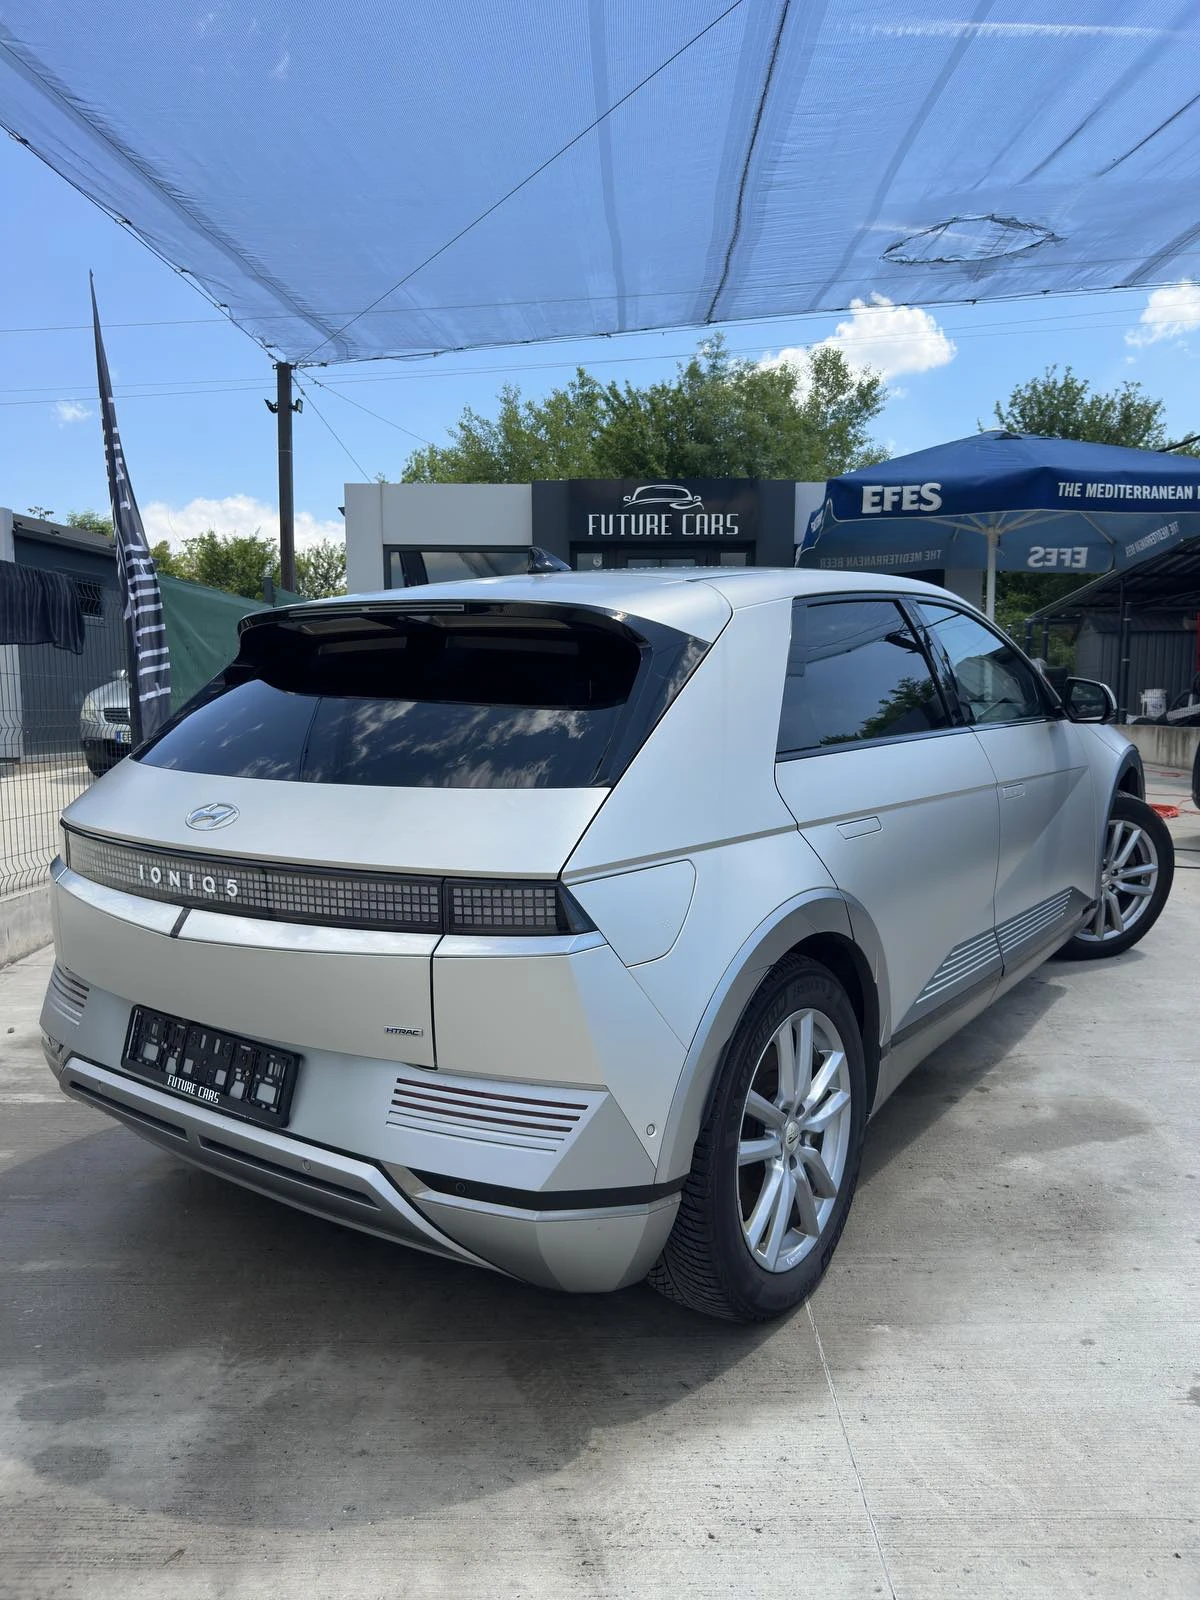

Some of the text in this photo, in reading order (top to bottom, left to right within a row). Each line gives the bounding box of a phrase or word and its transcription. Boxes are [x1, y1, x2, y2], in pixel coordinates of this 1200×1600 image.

[861, 483, 943, 514] EFES
[1058, 482, 1082, 498] THE
[1086, 483, 1193, 500] MEDITERRANEAN
[588, 513, 739, 536] FUTURE CARS
[385, 1027, 421, 1036] HTRAC
[167, 1074, 221, 1104] FUTURE CARS
